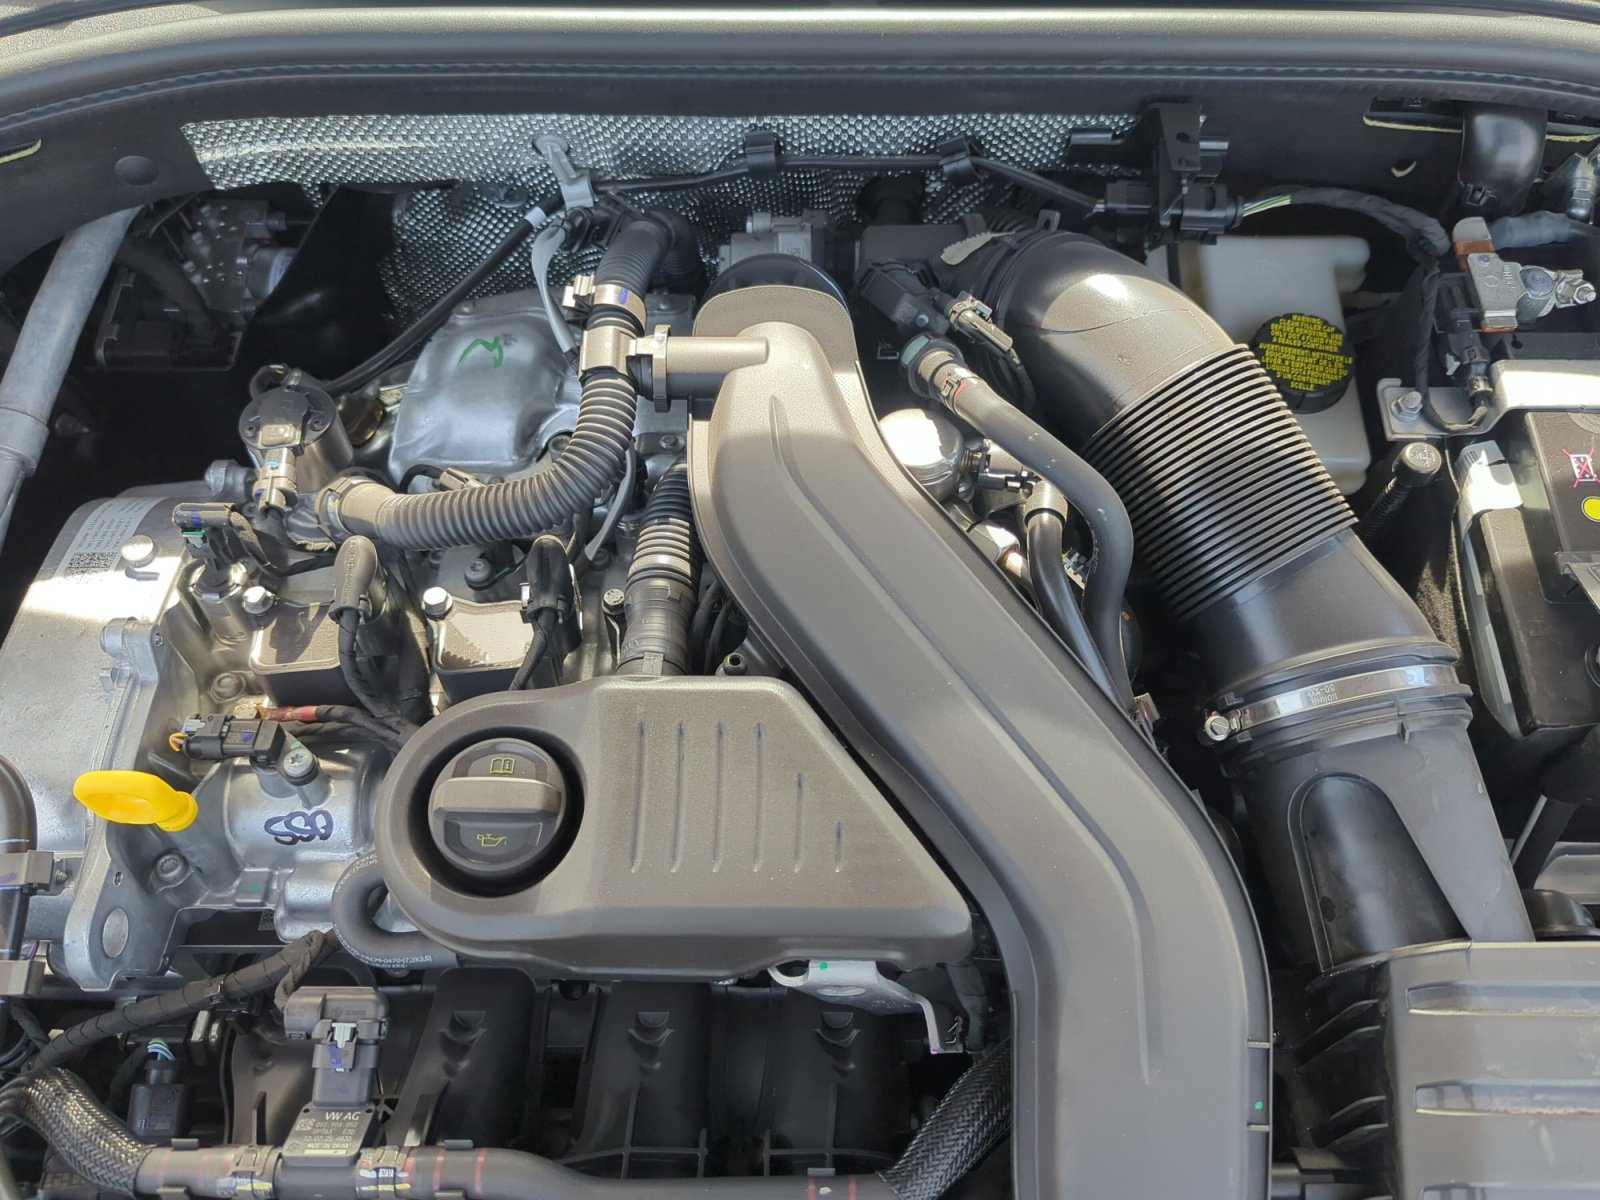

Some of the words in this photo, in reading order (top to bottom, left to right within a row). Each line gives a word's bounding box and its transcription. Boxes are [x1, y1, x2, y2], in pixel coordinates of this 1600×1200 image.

[1270, 323, 1295, 333] BEFORE
[1279, 319, 1299, 327] CLEAN
[1300, 322, 1321, 330] FILLER
[1306, 336, 1324, 344] FLUID
[1325, 339, 1342, 347] FROM
[1296, 356, 1317, 364] AVANT
[1312, 352, 1344, 362] NETTOYER
[325, 1111, 344, 1121] VW
[343, 1111, 361, 1121] AG
